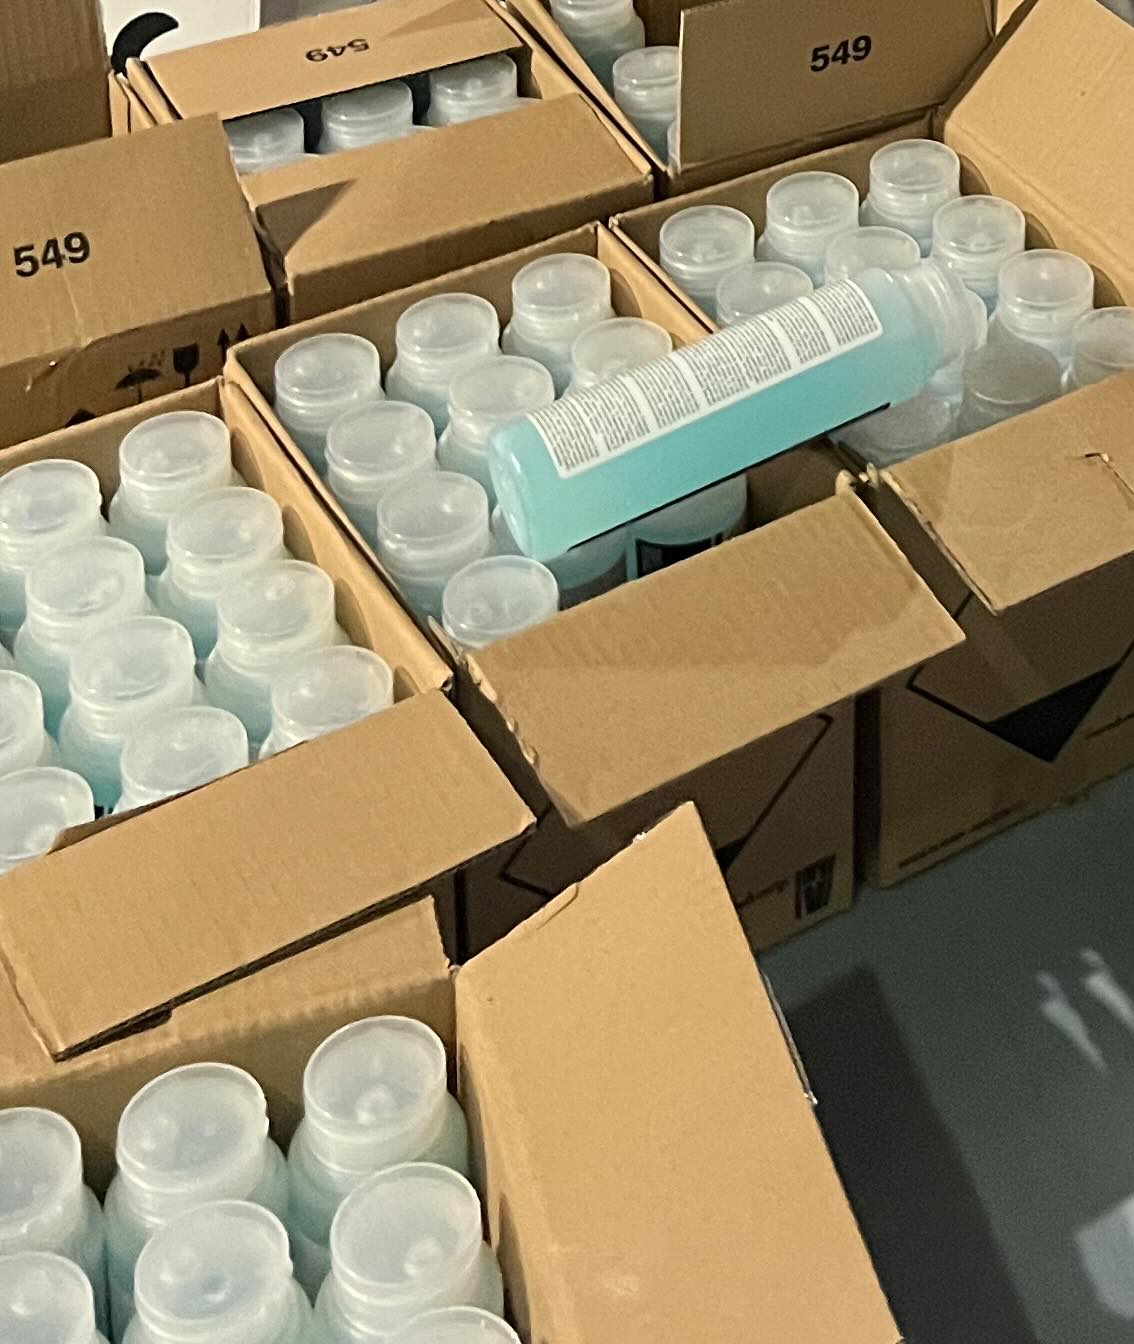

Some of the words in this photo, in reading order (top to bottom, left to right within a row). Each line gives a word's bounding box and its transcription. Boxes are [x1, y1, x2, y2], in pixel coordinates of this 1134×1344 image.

[305, 38, 369, 62] 549
[810, 35, 872, 72] 549
[14, 231, 90, 278] 549
